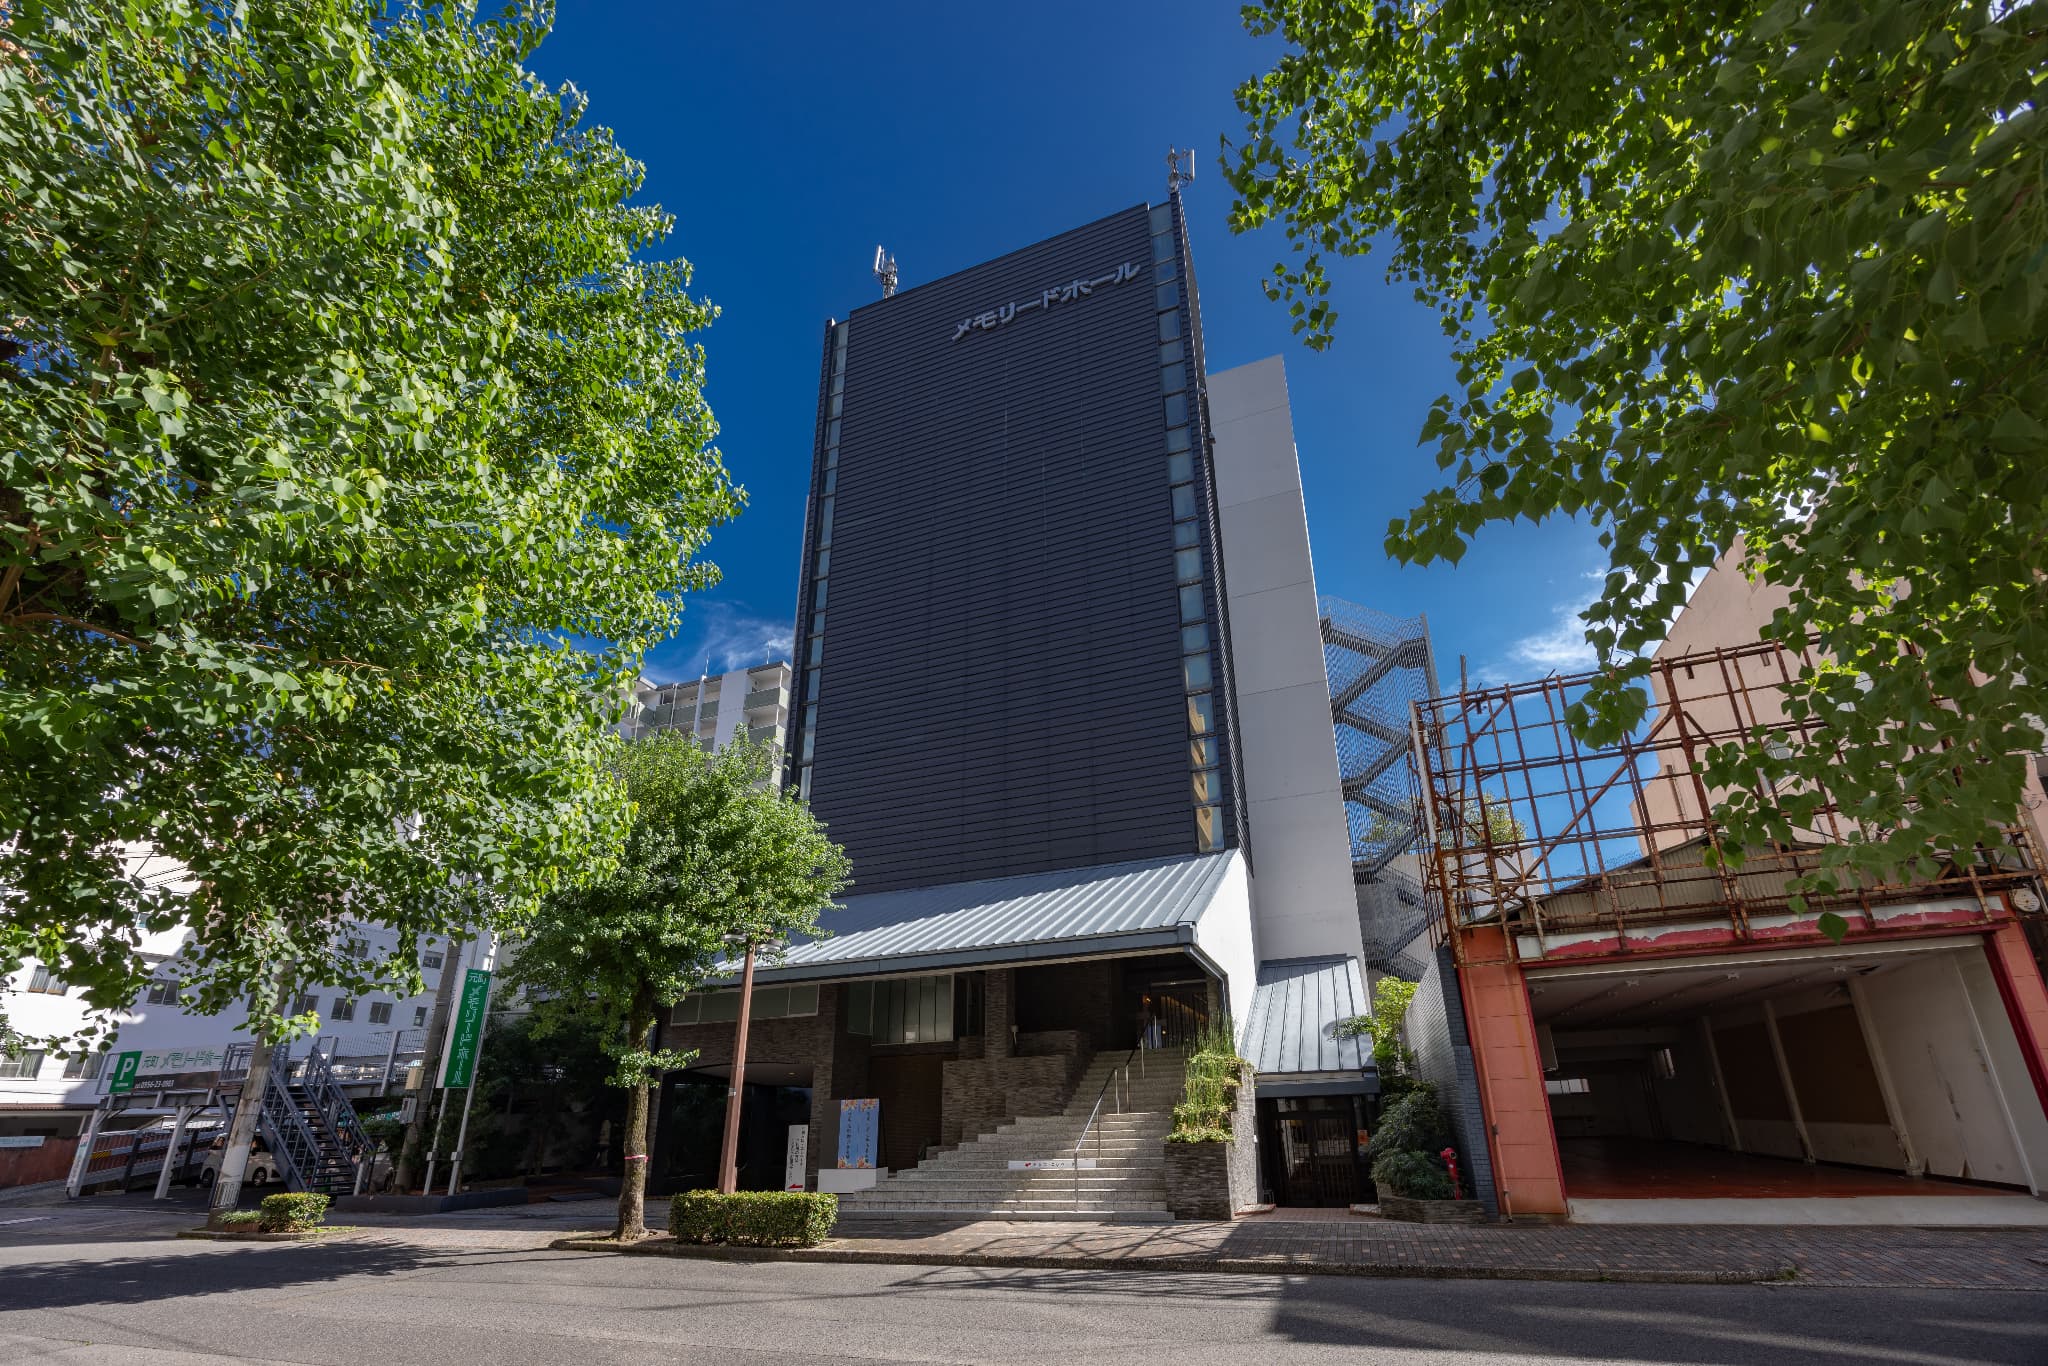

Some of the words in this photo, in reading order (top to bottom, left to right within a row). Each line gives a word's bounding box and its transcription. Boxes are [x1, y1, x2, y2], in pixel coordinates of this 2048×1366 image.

[952, 262, 1141, 341] メモリードホール
[120, 1057, 135, 1081] P
[162, 1049, 225, 1069] メモリードホー
